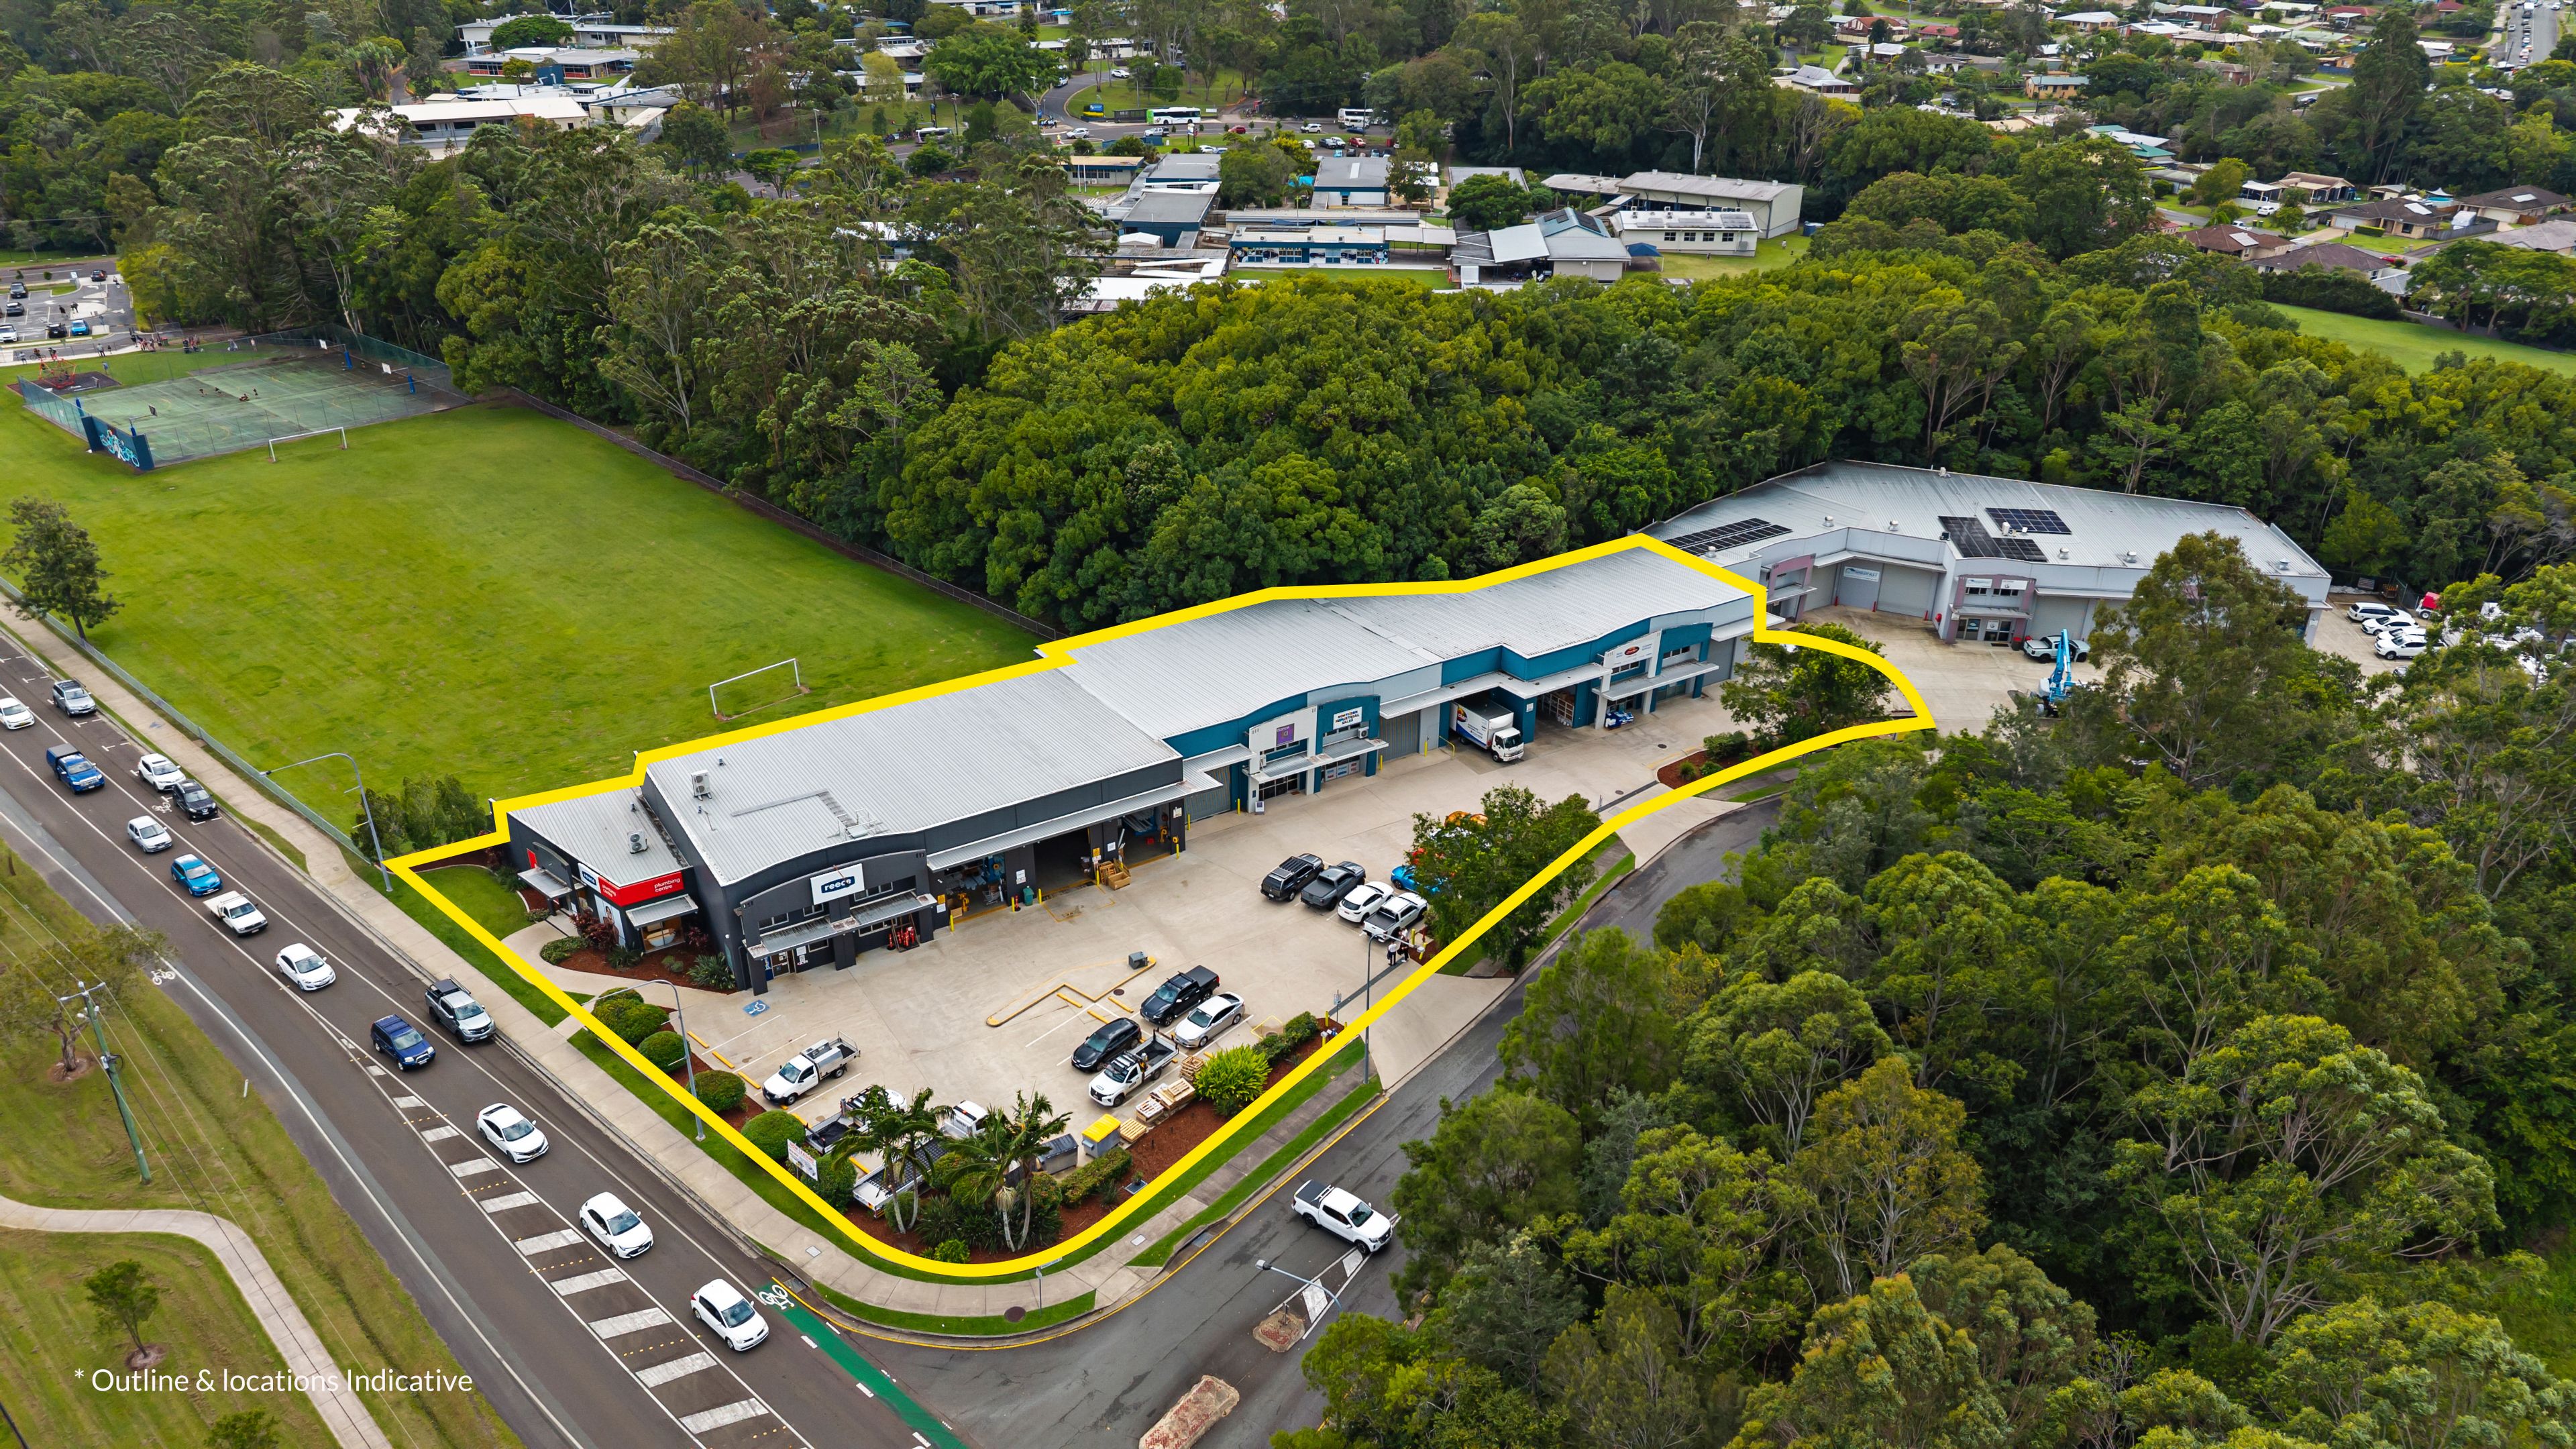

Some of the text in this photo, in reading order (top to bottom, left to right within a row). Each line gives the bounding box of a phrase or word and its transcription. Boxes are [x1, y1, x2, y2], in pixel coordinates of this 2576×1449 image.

[1335, 713, 1360, 723] INDUSTRIAL
[1338, 710, 1358, 718] NORTHERN
[654, 877, 680, 889] plumbing
[655, 884, 673, 892] centre
[824, 878, 852, 891] reece
